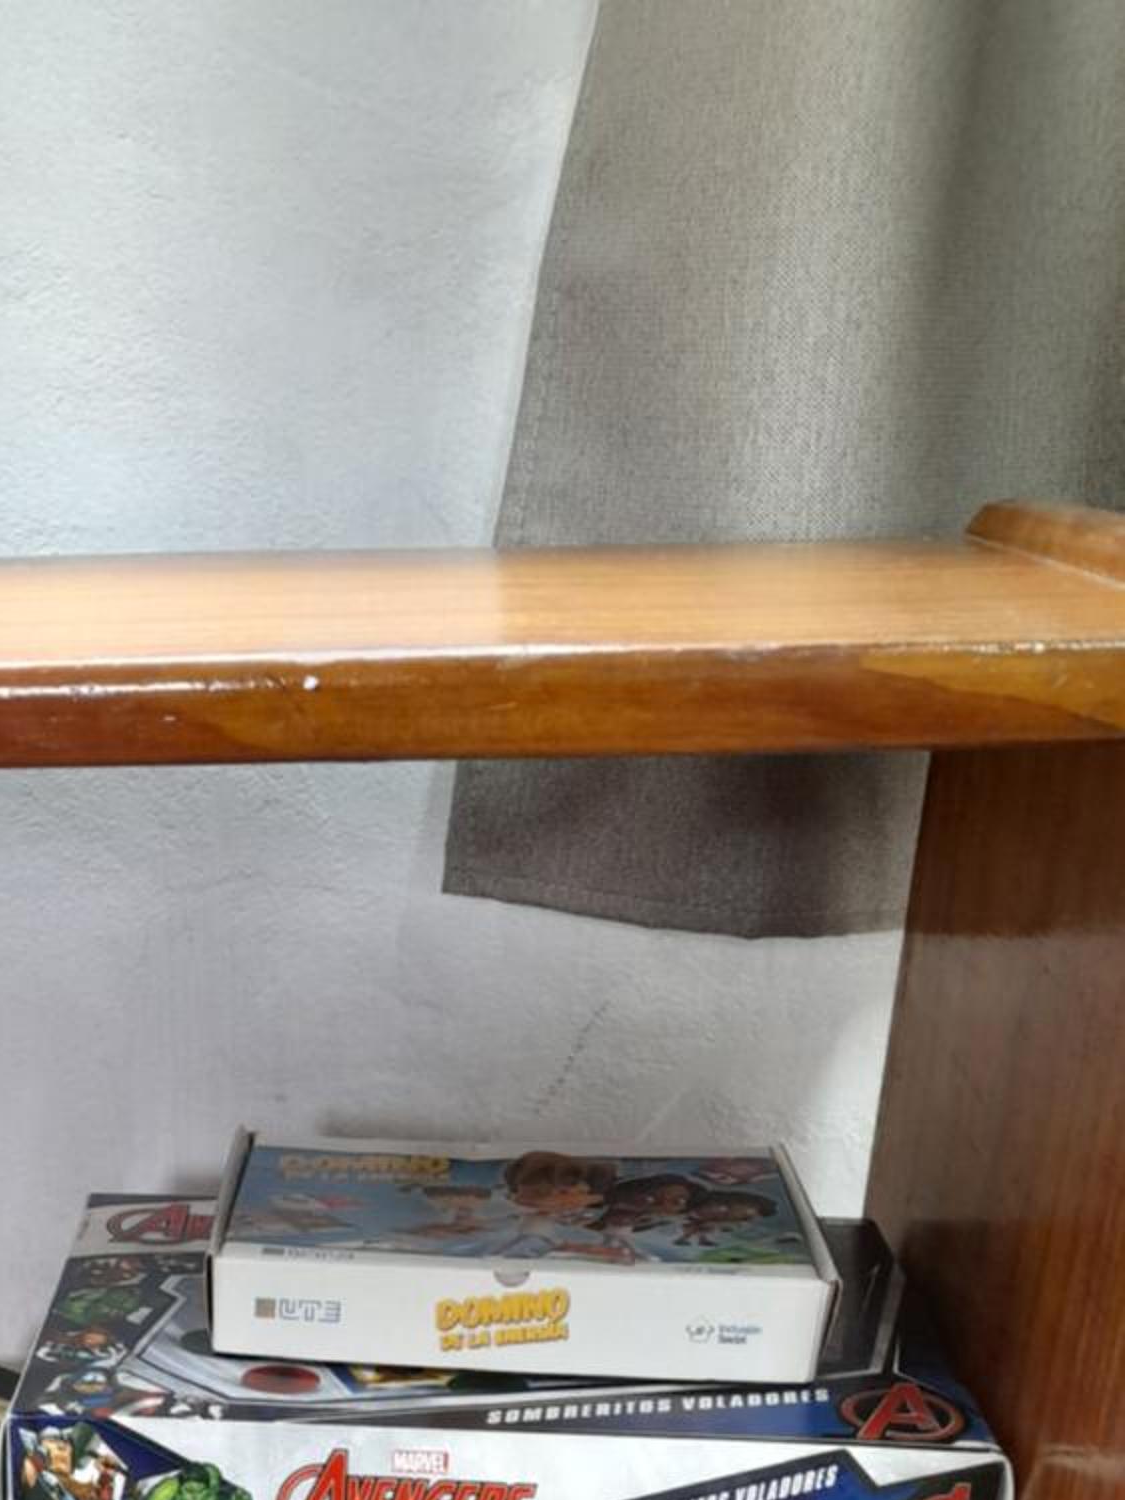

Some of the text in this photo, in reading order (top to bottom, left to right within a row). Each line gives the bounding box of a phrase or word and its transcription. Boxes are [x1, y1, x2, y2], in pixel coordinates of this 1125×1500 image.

[279, 1297, 343, 1323] UTE
[435, 1286, 571, 1332] DOMINO
[485, 1388, 831, 1425] SOMBRERITOS VOLADORES
